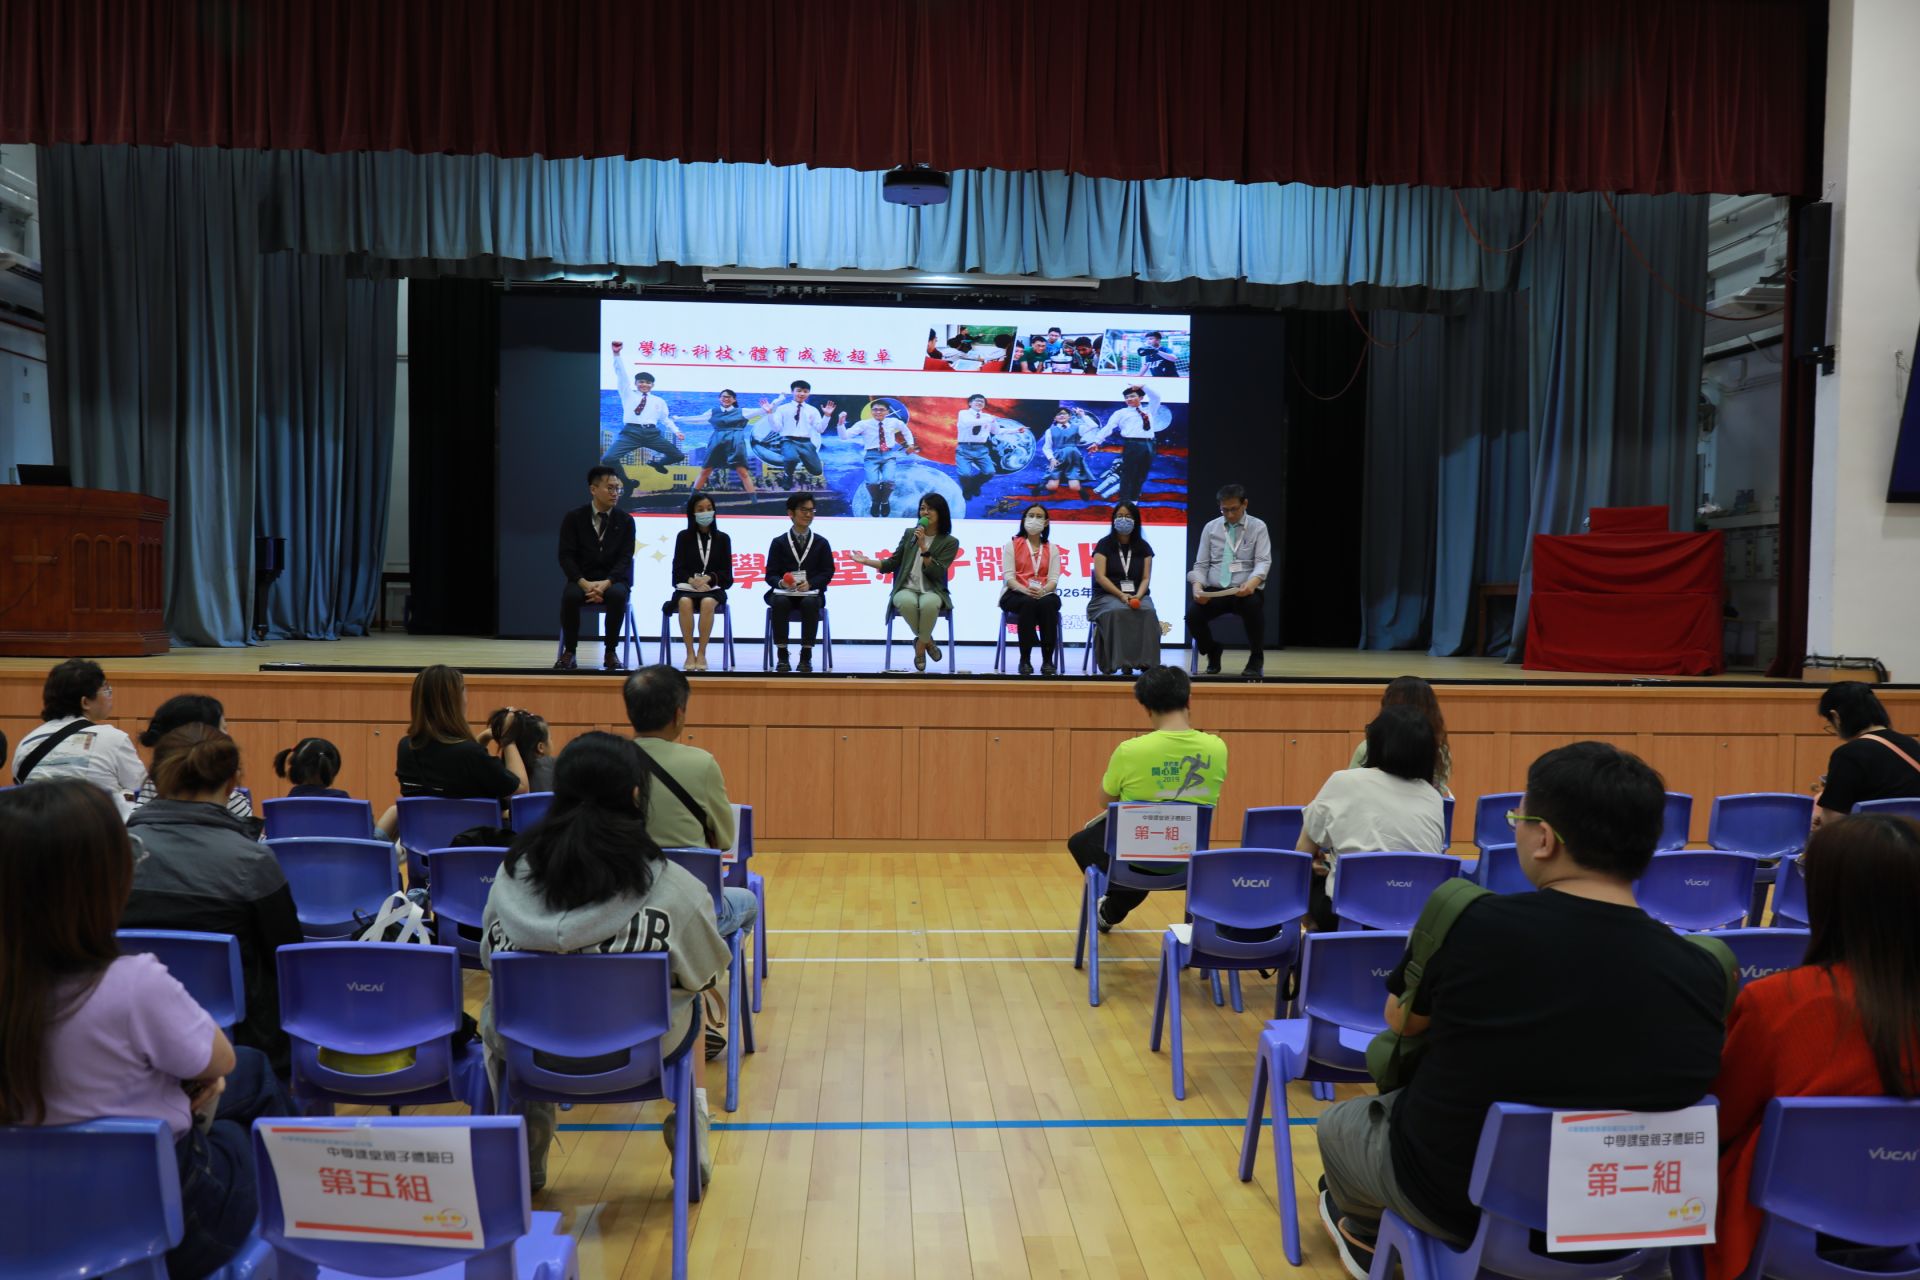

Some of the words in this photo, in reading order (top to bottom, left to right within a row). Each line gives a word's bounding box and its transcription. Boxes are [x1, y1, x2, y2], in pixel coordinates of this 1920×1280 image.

[1134, 825, 1180, 841] 第一組
[1231, 876, 1272, 888] VUCAI
[1740, 964, 1789, 979] VUC
[346, 981, 385, 992] VUCAI
[1603, 1131, 1705, 1148] 中學課堂親子體驗日
[1868, 1146, 1919, 1161] VUCAI
[317, 1166, 433, 1204] 第五組
[1587, 1160, 1682, 1198] 第二組
